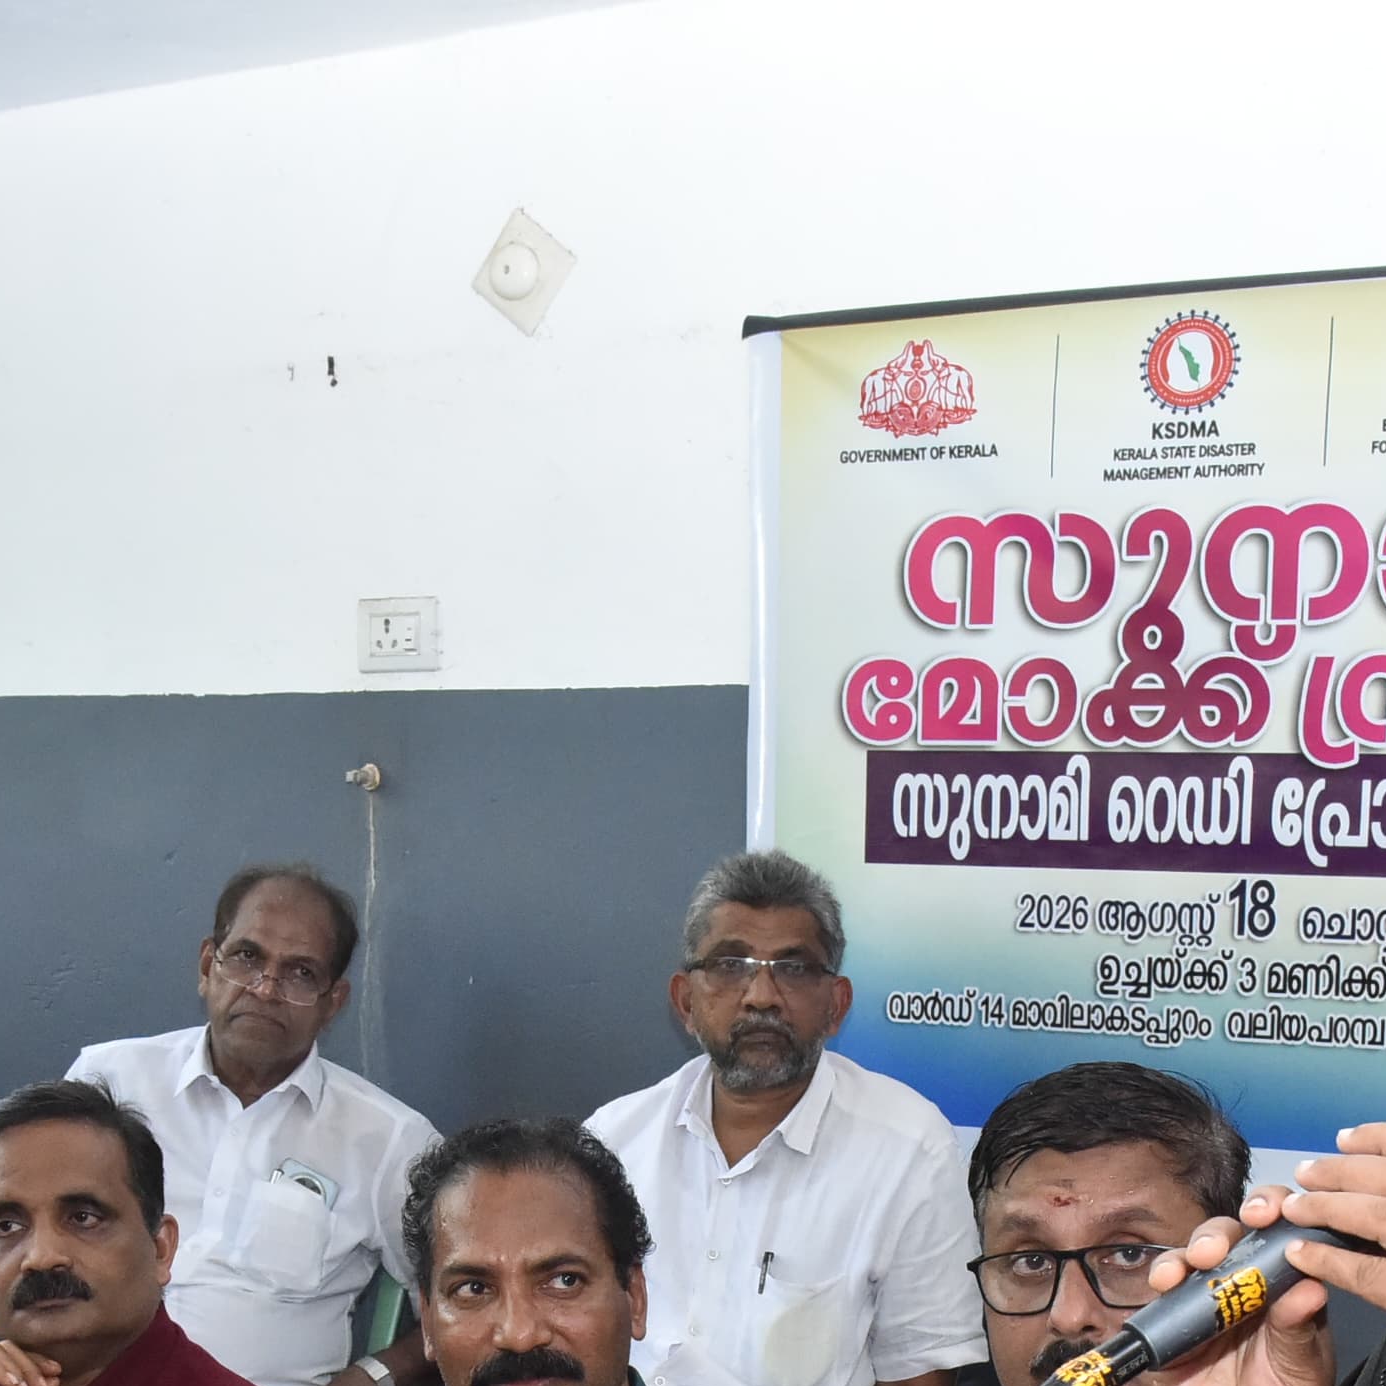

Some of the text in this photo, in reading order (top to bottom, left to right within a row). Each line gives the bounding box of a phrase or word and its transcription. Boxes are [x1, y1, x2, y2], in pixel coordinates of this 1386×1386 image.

[1151, 421, 1220, 440] KSDMA
[839, 443, 998, 464] GOVERNMENT OF KERALA
[1113, 442, 1256, 461] KERALA STATE DISASTER
[1103, 463, 1265, 481] MANAGEMENT AUTHORITY
[893, 753, 1090, 860] സുനാമി
[1107, 755, 1253, 845] റെഡി
[1018, 895, 1088, 929] 2026
[1228, 879, 1276, 937] 18
[1098, 947, 1230, 997] ഉച്ചയ്ക്ക്
[1240, 959, 1256, 991] 3
[890, 989, 976, 1024] വാർഡ്
[981, 995, 1004, 1025] 14
[1013, 994, 1212, 1045] മാവിലാകടപ്പുറം
[1229, 1005, 1385, 1046] വലിയപറമ്പ
